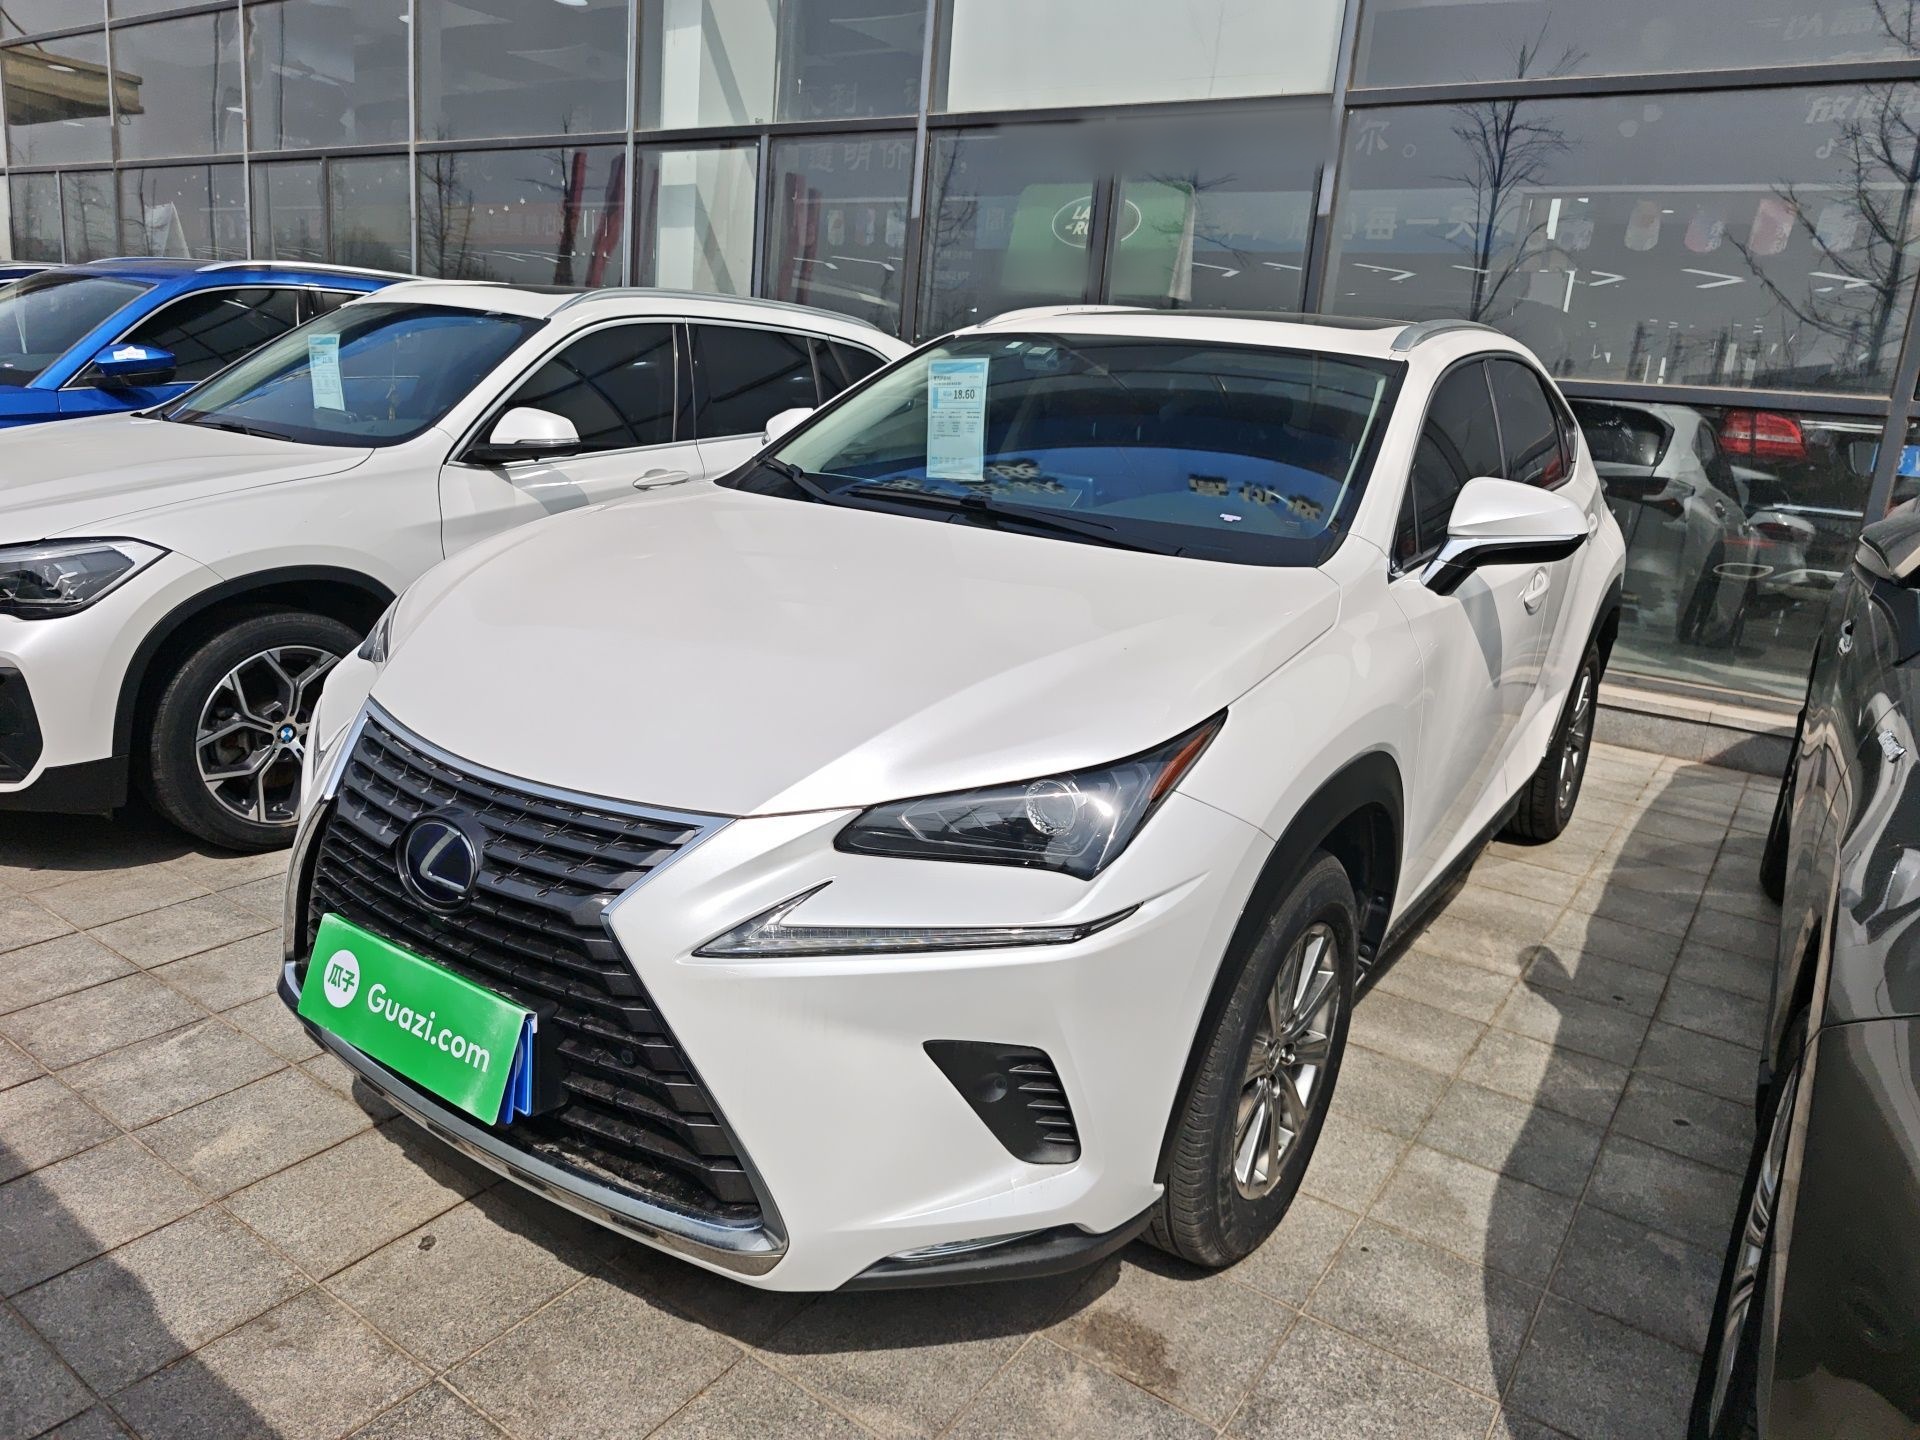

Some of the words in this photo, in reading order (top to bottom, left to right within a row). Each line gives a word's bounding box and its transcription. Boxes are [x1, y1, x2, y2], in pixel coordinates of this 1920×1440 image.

[953, 389, 975, 400] 18.60
[327, 963, 356, 993] 瓜子
[367, 983, 491, 1073] Guazi.com
